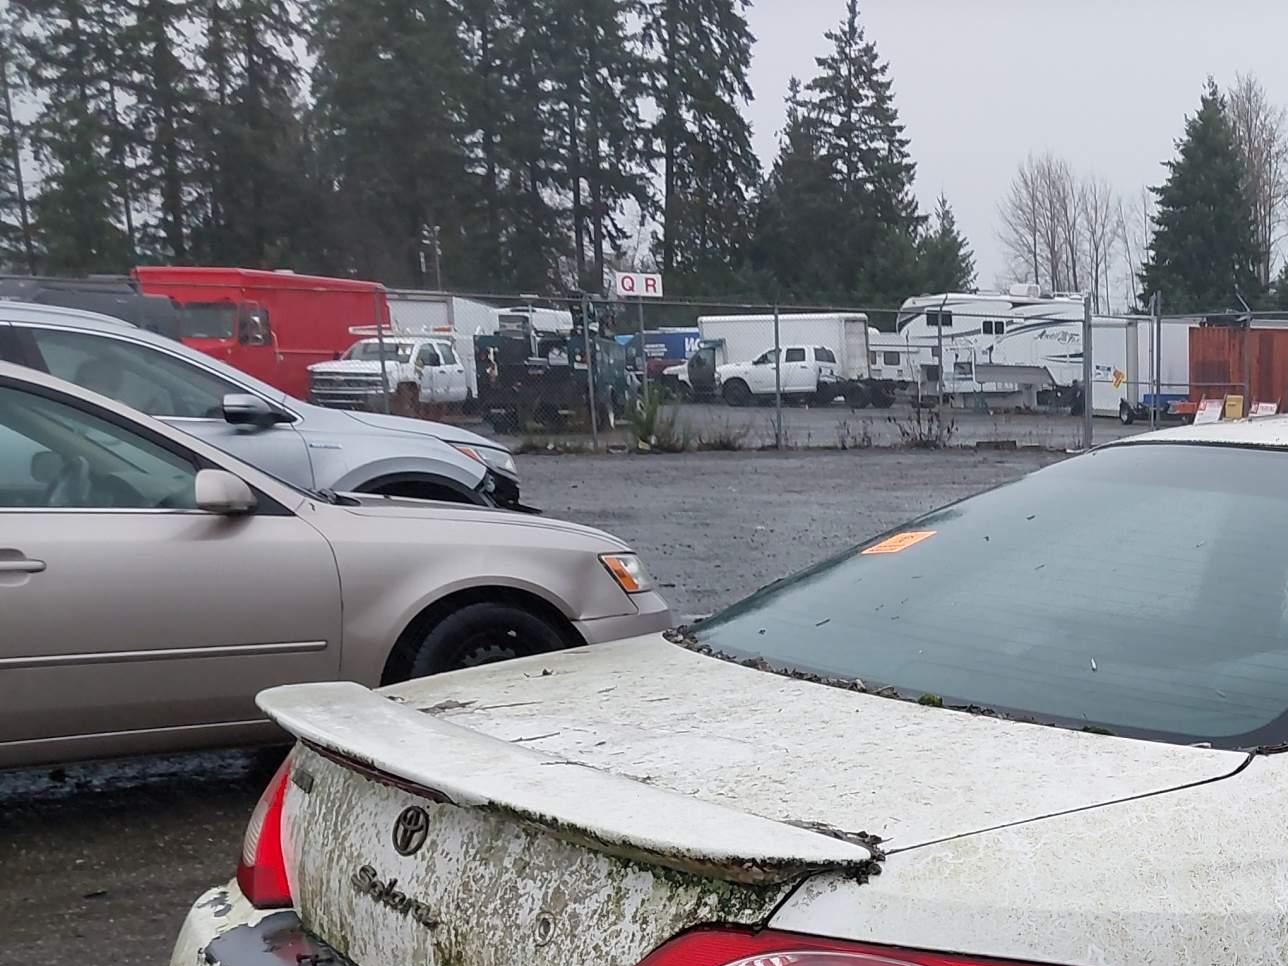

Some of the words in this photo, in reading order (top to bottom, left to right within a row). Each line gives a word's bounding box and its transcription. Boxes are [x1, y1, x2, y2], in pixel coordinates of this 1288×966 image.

[621, 275, 635, 292] Q
[644, 277, 657, 293] R
[351, 864, 440, 928] Solara
